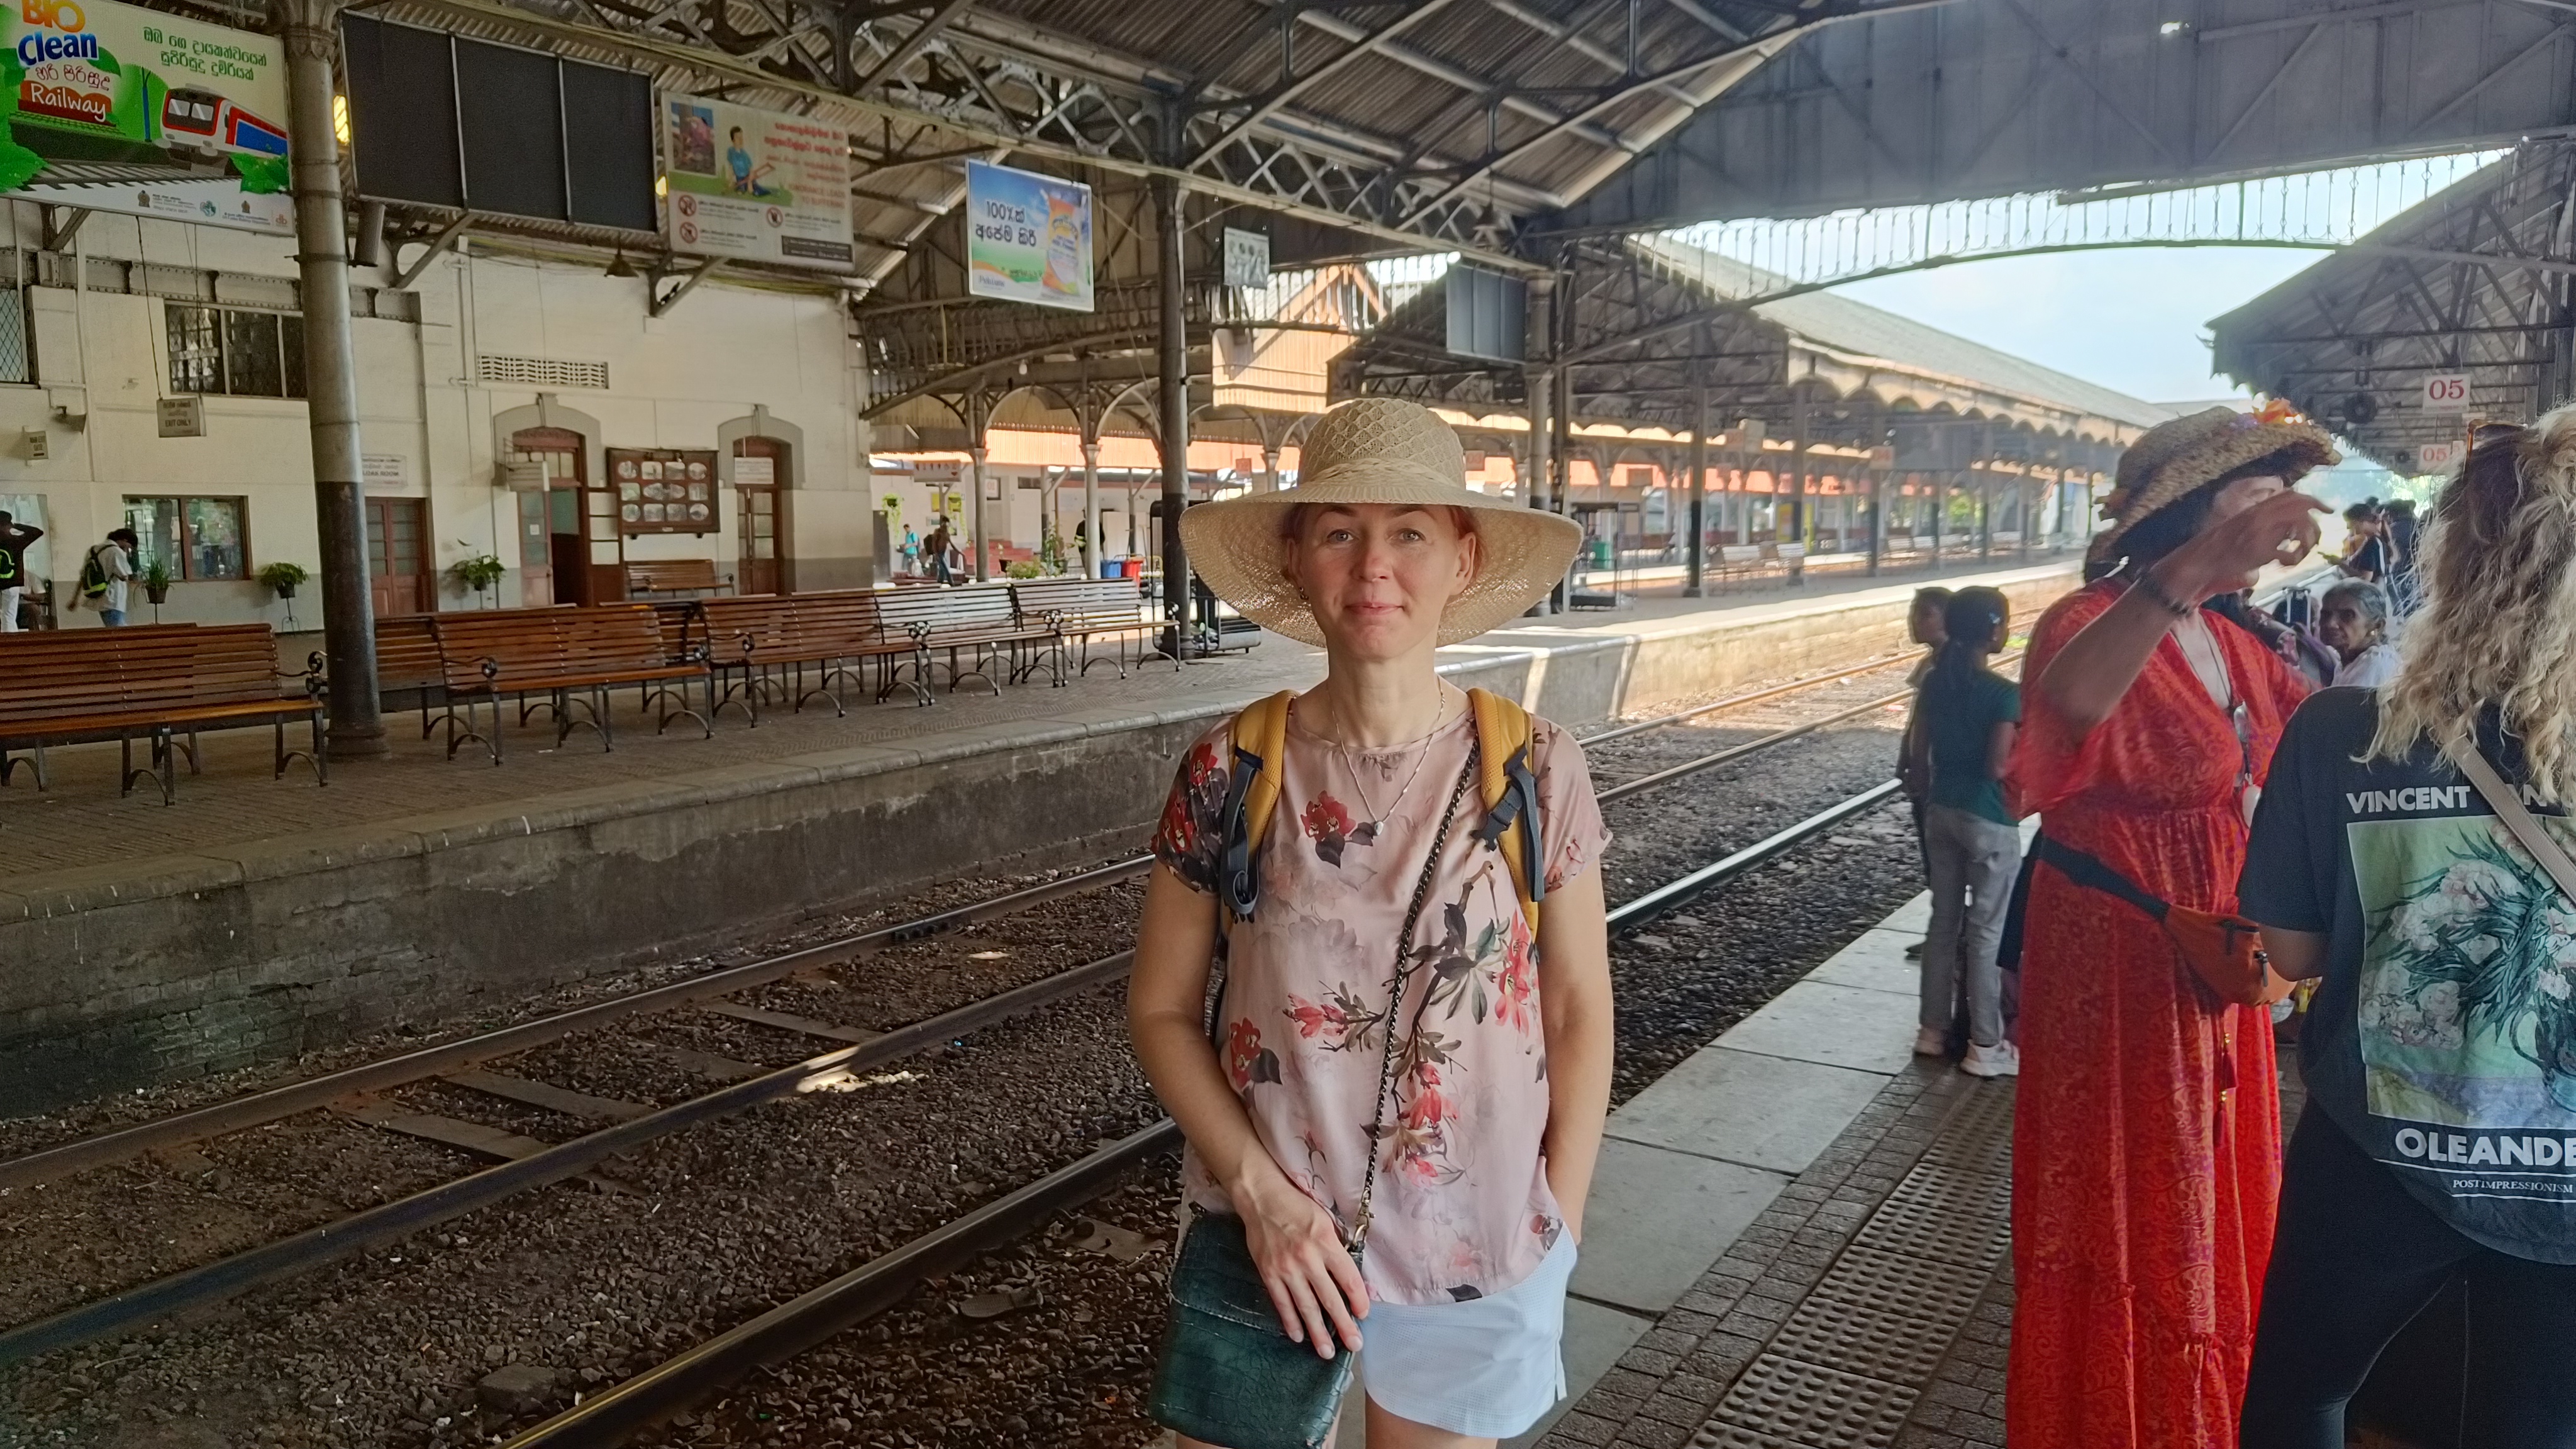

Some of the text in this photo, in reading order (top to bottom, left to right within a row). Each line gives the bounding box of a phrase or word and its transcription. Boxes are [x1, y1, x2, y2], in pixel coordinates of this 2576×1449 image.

[18, 31, 97, 65] clean
[64, 64, 110, 91] පිරිසුදු
[31, 82, 106, 123] Railway
[2429, 379, 2464, 400] 05
[2423, 447, 2447, 462] 05
[2346, 786, 2470, 814] VINCENT
[2453, 1179, 2573, 1193] POSTIMPRESSIONISM
